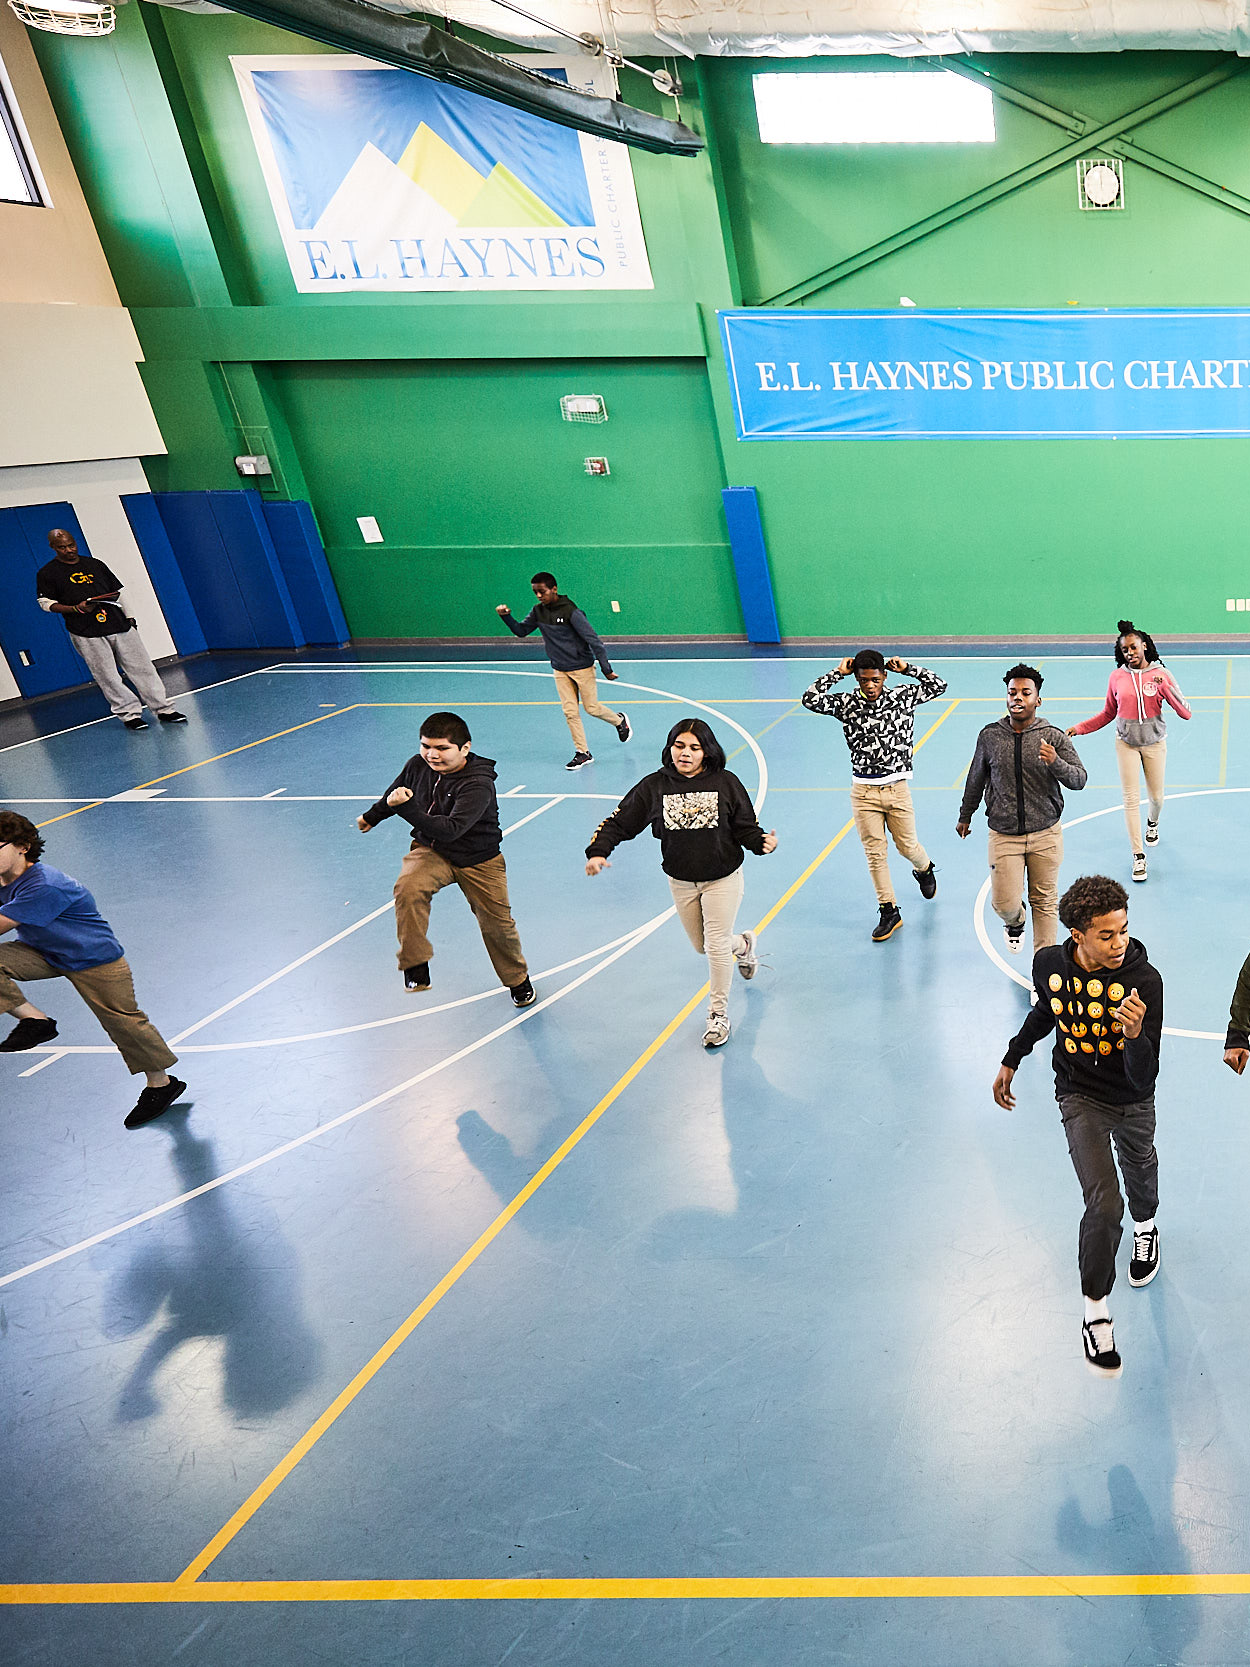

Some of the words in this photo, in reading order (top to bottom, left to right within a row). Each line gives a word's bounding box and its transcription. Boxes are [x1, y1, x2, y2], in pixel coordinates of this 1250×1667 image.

[598, 149, 618, 213] CHARTER
[300, 239, 388, 280] E.L.
[390, 237, 606, 279] HAYNES
[611, 219, 629, 267] PUBLIC
[755, 361, 822, 392] E.L.
[829, 361, 973, 391] HAYNES
[980, 360, 1114, 390] PUBLIC
